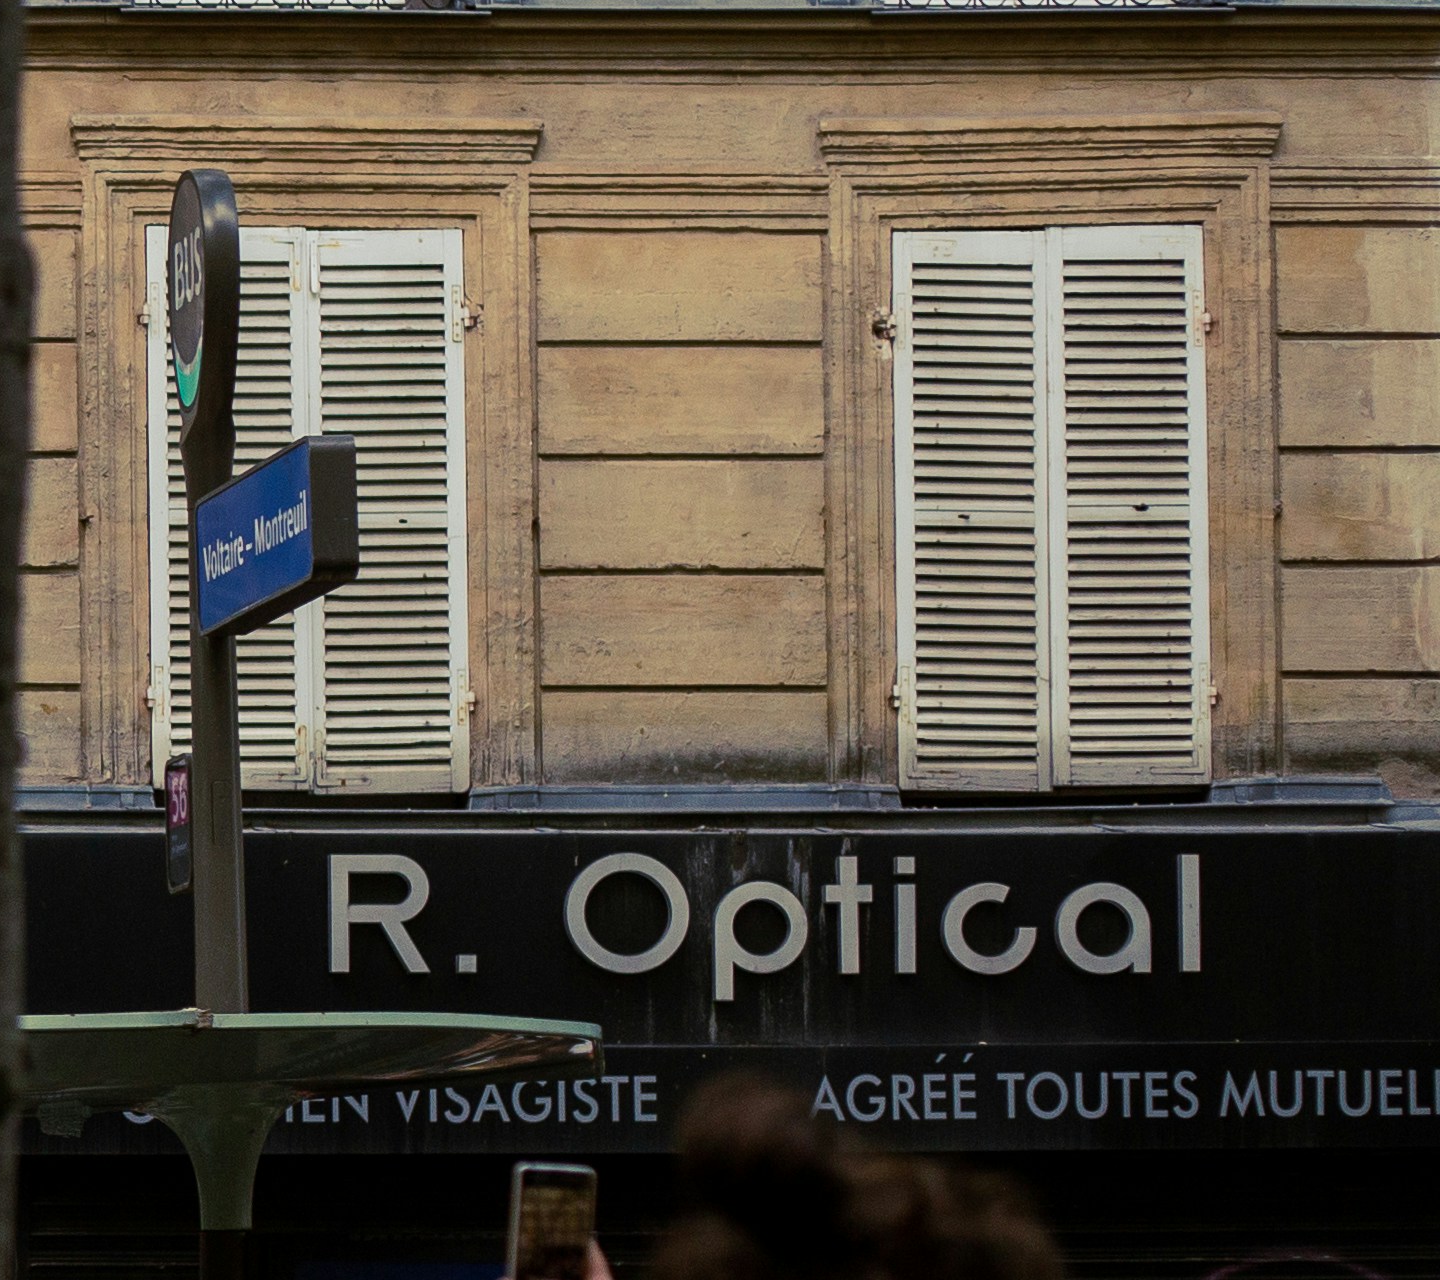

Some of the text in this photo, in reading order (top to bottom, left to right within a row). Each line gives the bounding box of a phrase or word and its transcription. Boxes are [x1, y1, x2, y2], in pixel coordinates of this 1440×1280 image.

[174, 226, 202, 311] BUS
[203, 532, 245, 582] Voltaire
[254, 490, 308, 558] Montreuil
[327, 851, 1202, 1002] R. Optical
[397, 1074, 659, 1124] VISAGISTE
[812, 1052, 978, 1122] AGRÉÉ
[996, 1070, 1200, 1121] TOUTES
[1220, 1069, 1440, 1119] MUTUEL
